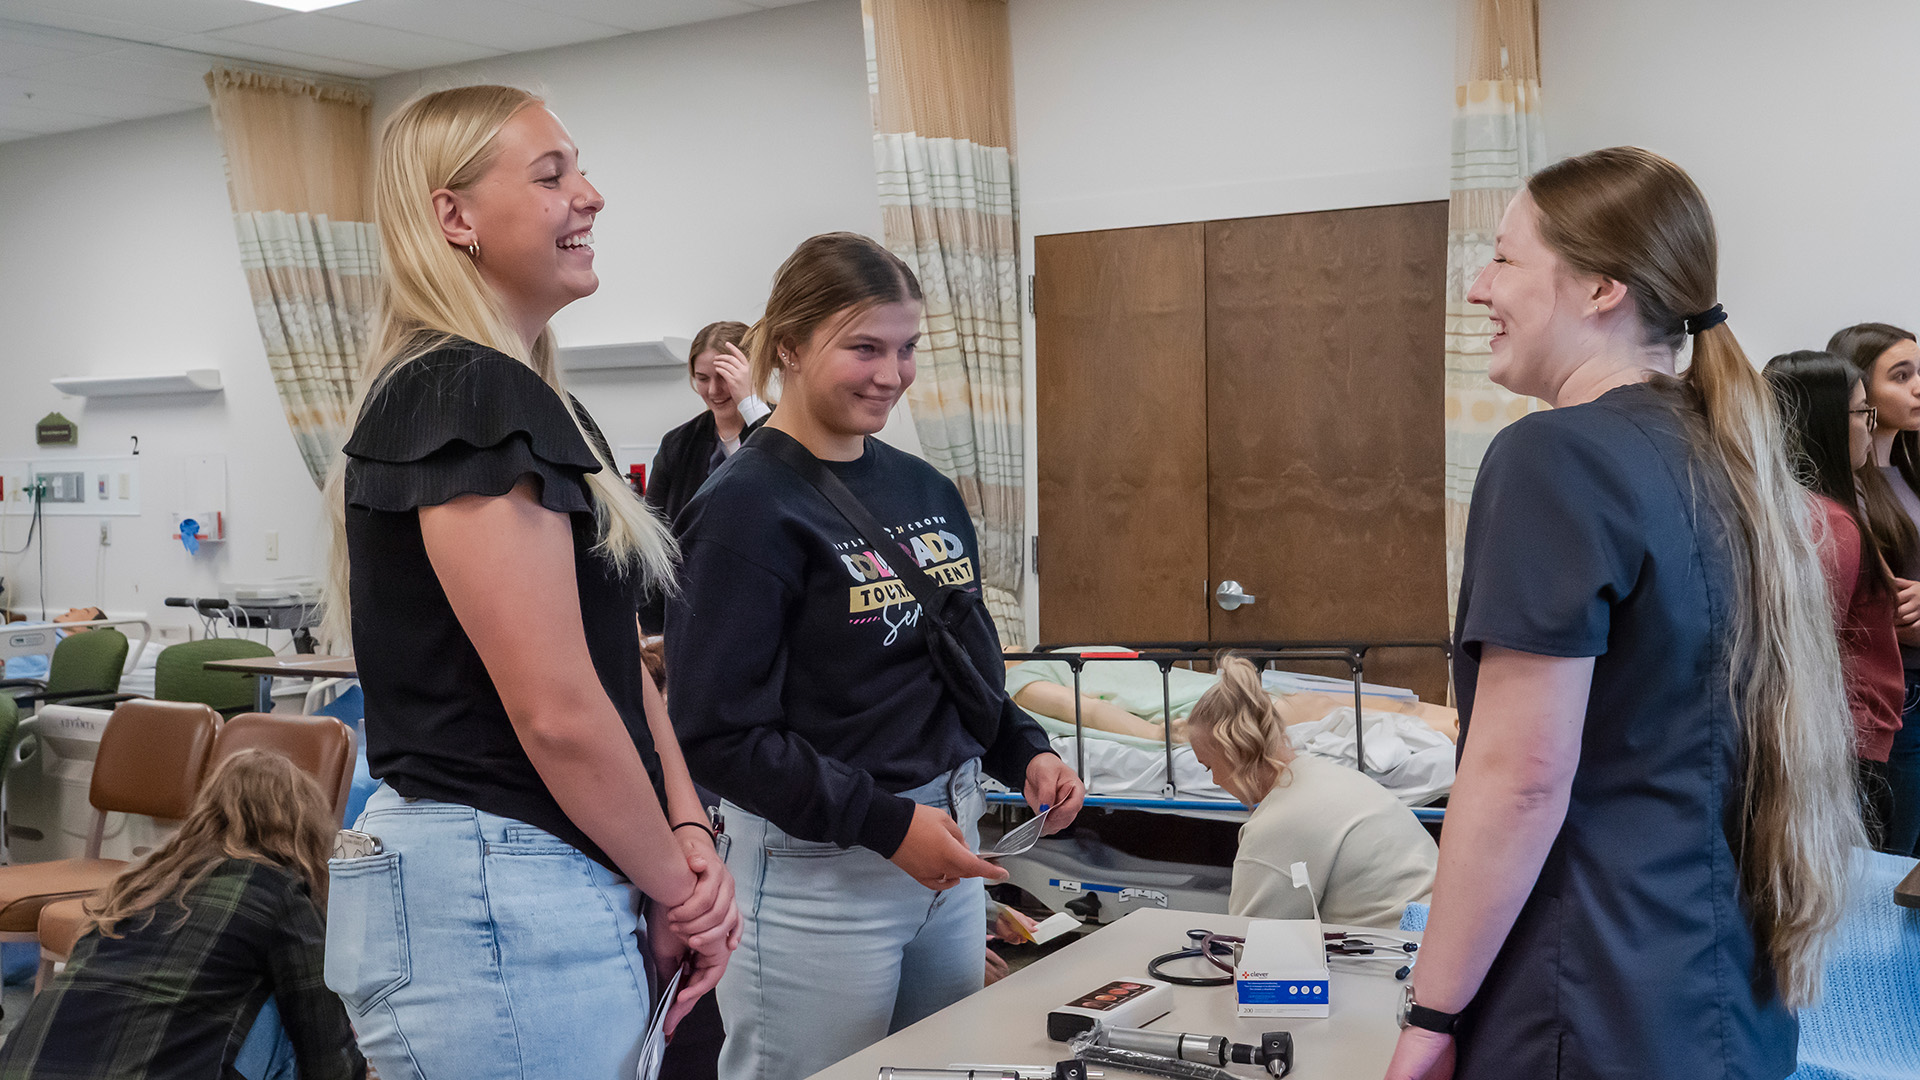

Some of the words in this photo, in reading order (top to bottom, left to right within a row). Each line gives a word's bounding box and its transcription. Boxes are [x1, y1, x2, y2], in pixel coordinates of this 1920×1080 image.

[130, 435, 140, 456] 2
[907, 516, 947, 531] CROWN
[840, 529, 964, 583] COLADO
[860, 562, 971, 606] TOURMENT
